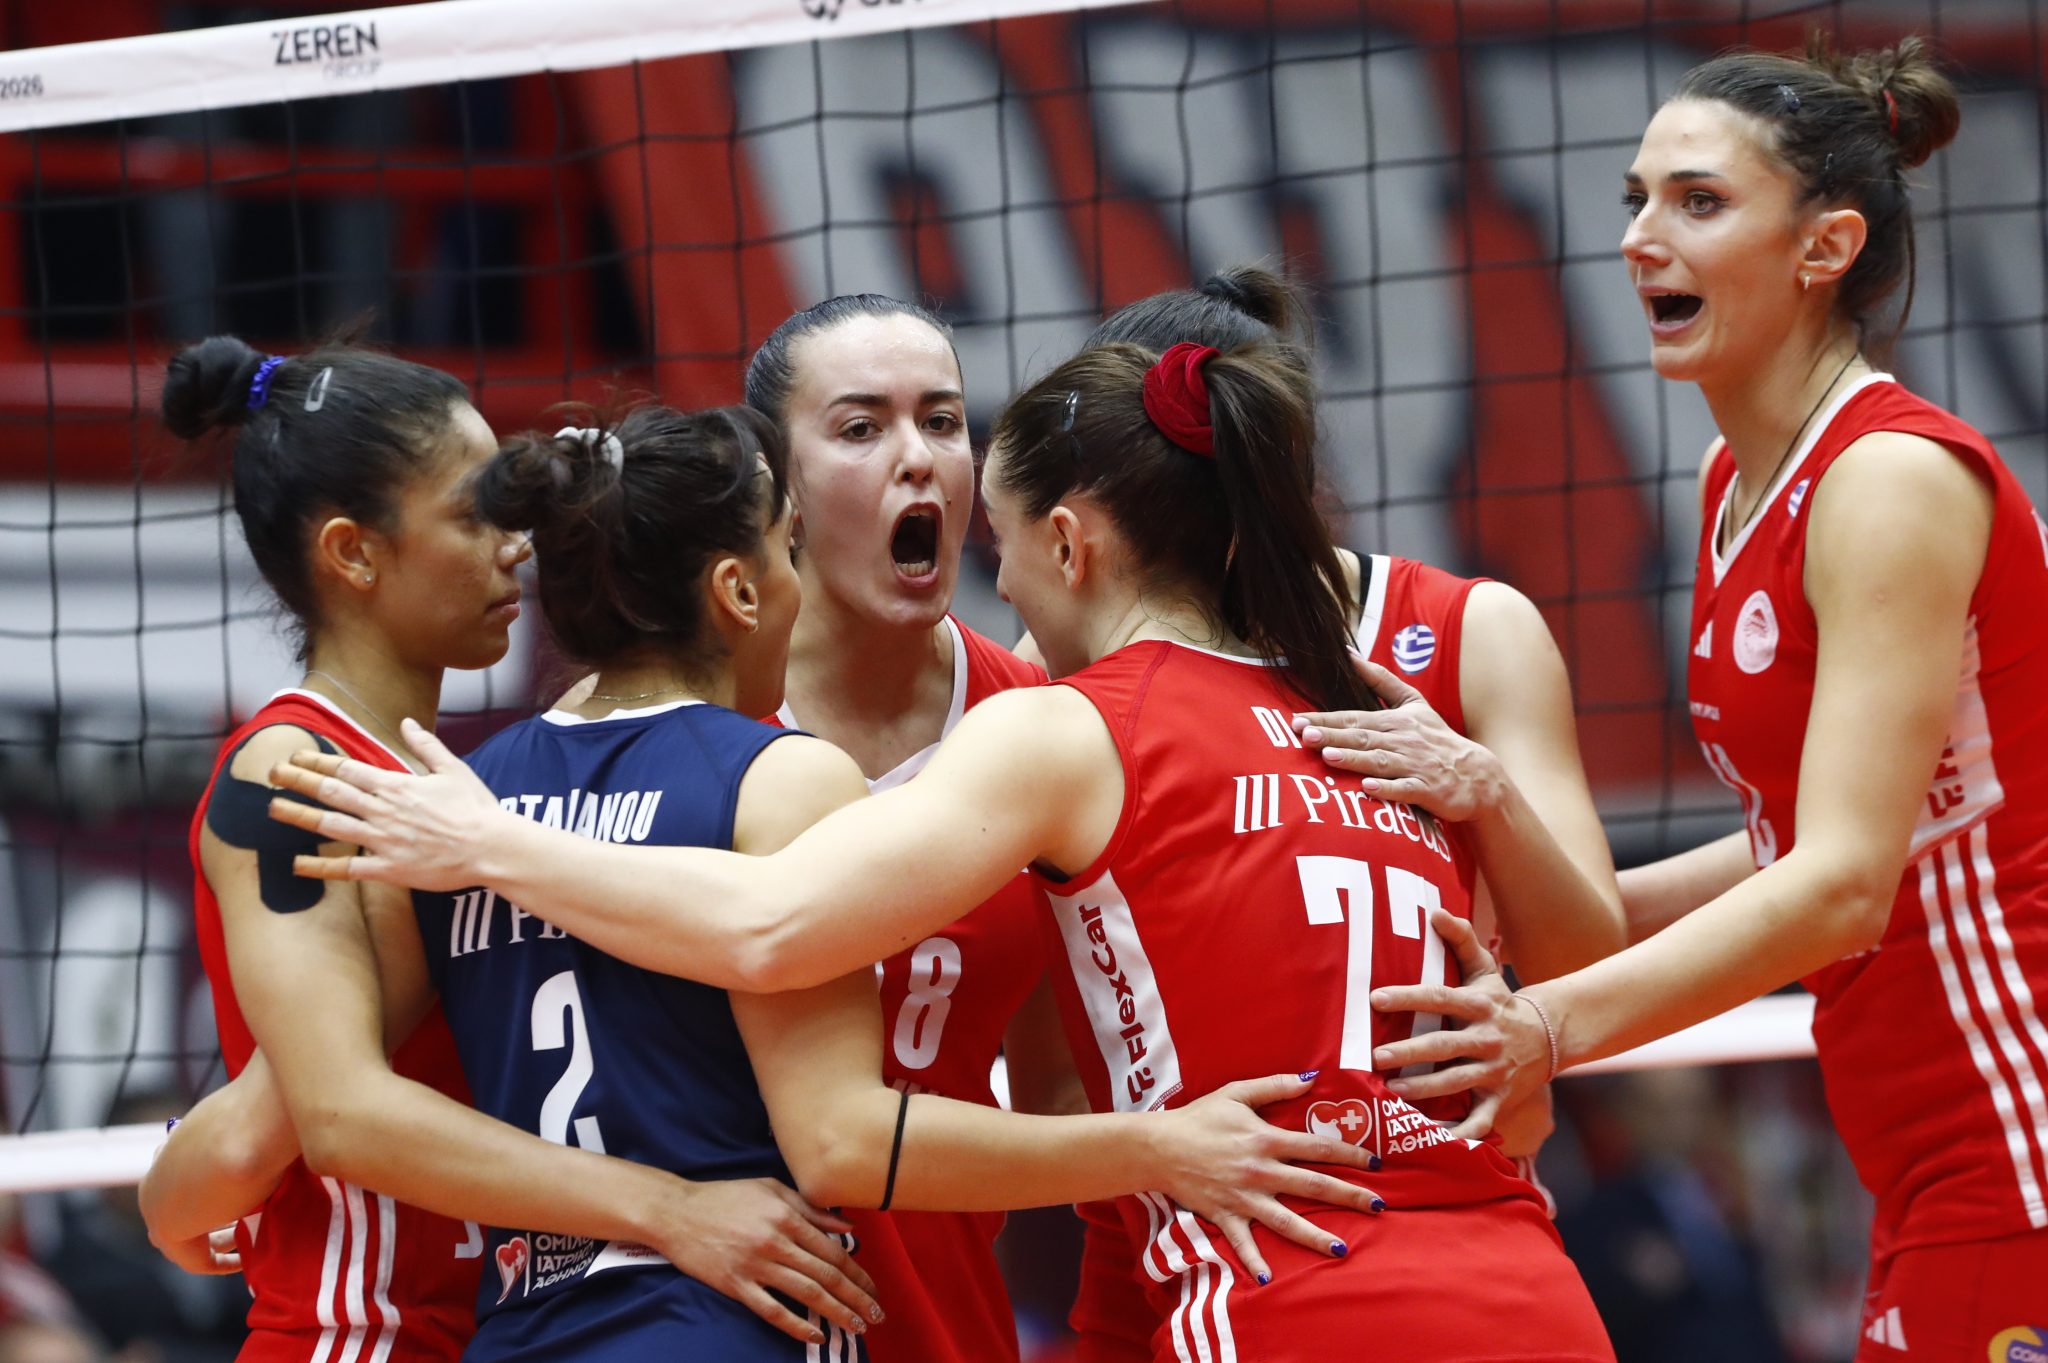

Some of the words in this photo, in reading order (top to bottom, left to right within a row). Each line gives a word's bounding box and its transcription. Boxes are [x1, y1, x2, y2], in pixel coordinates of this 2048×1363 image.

[271, 21, 379, 65] ZEREN
[1251, 706, 1303, 749] DI
[1287, 773, 1452, 863] Piraeus
[875, 936, 962, 1070] 8
[1078, 903, 1148, 1066] FlexCar
[1296, 855, 1445, 1077] 77
[531, 970, 606, 1155] 2
[1387, 1127, 1458, 1155] ΑΘΗΝΩ
